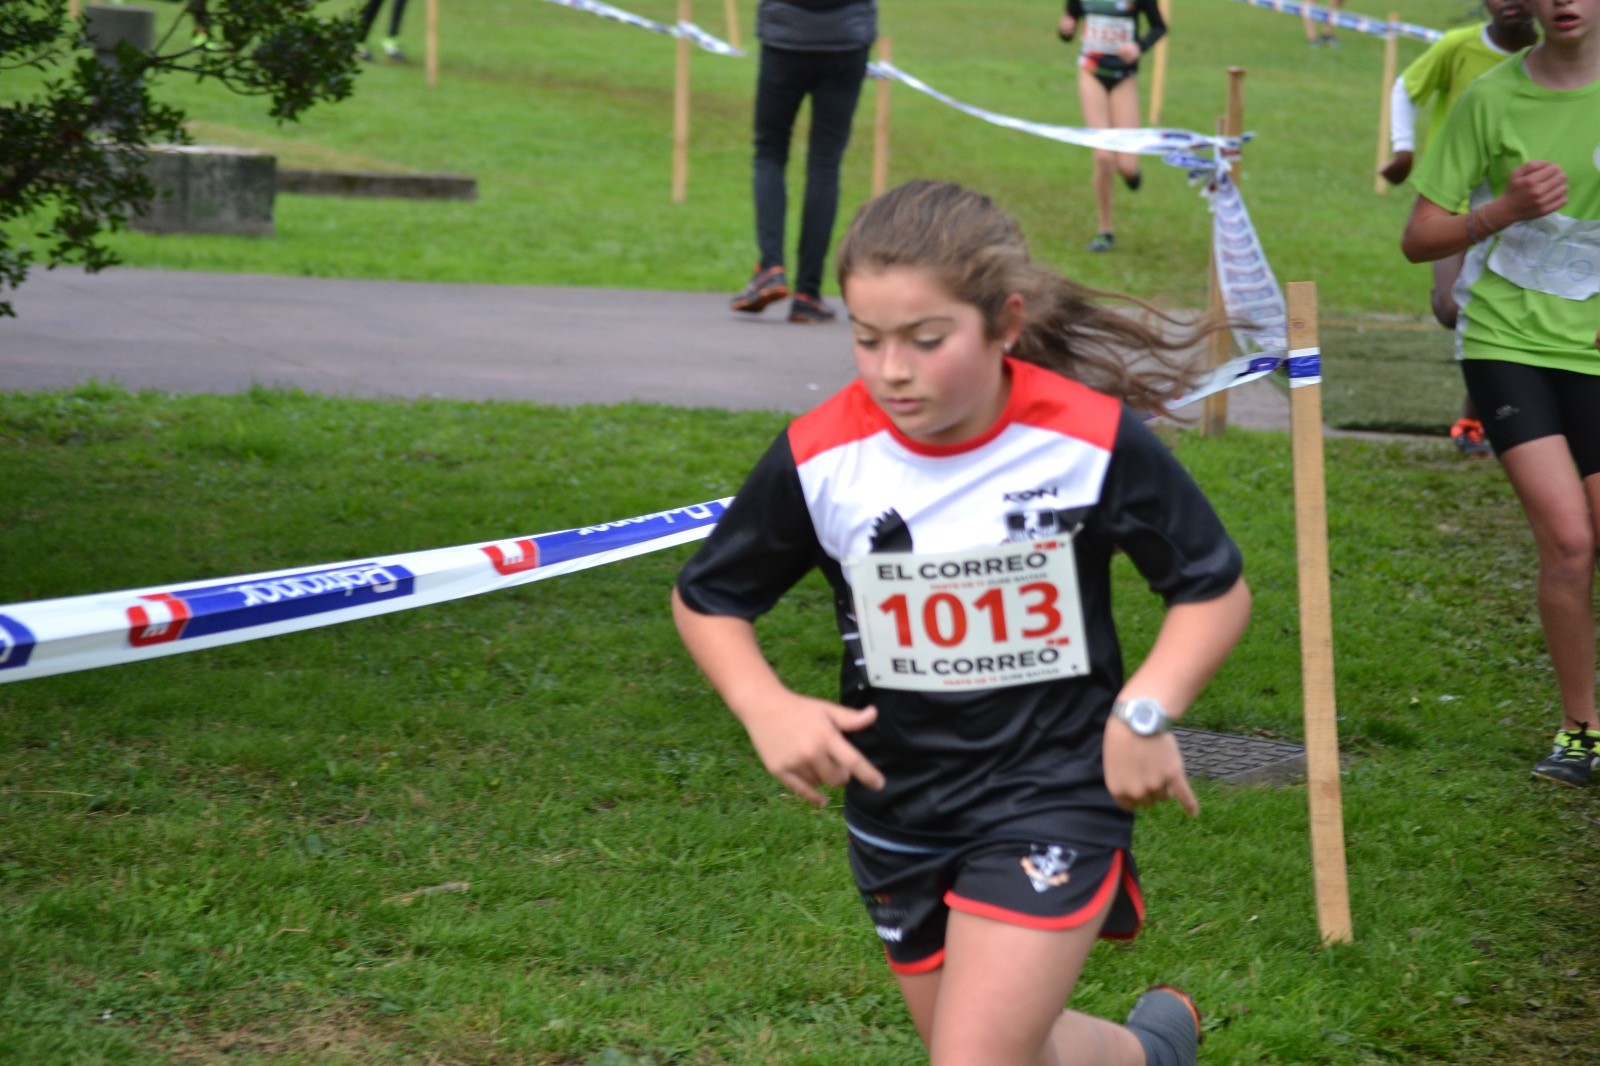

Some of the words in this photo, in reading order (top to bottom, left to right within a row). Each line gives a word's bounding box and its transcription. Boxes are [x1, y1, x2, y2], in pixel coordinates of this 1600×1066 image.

[876, 563, 913, 581] EL
[918, 552, 1047, 581] CORREO
[878, 581, 1062, 648] 1013
[890, 657, 927, 676] EL
[932, 648, 1060, 675] CORREO
